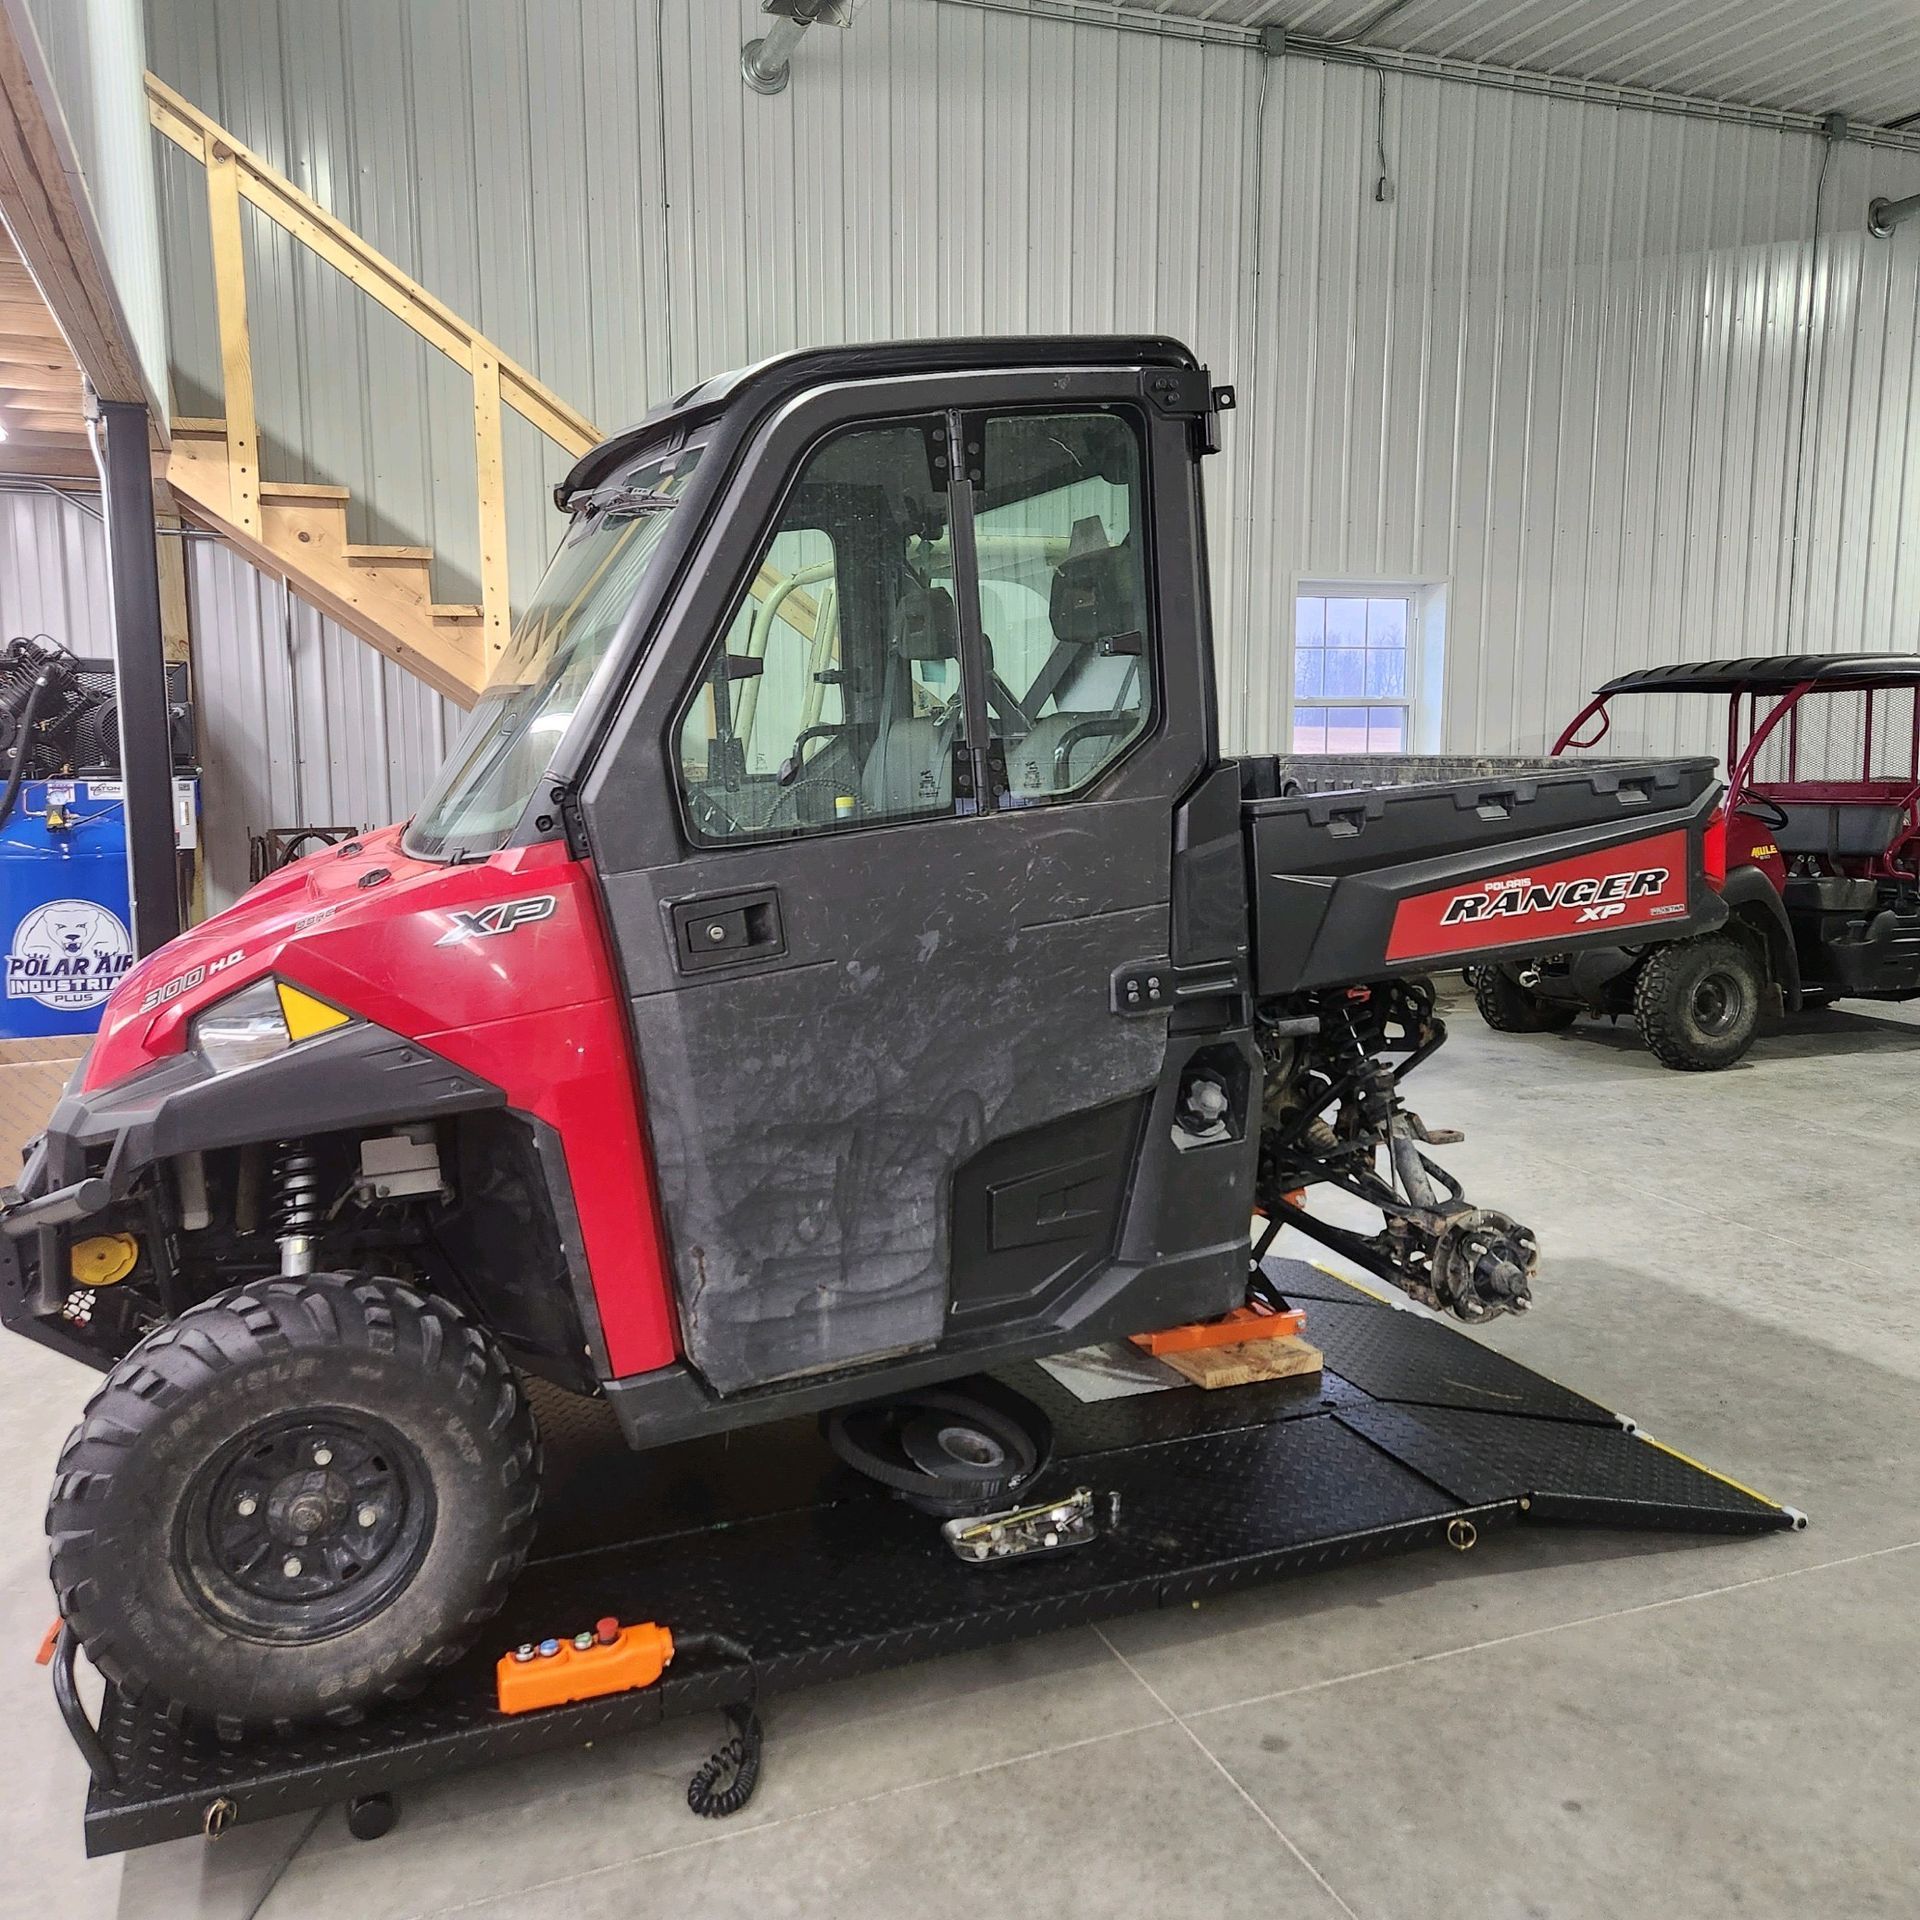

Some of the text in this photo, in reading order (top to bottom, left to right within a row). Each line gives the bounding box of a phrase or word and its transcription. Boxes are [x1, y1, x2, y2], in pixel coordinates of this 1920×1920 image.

[1751, 845, 1778, 858] MULE
[1485, 878, 1532, 892] POLARIS
[1440, 868, 1669, 926] RANGER
[433, 895, 556, 948] XP
[1575, 903, 1627, 924] XP
[10, 957, 90, 976] POLAR
[10, 976, 121, 994] INDUSTRIA
[55, 994, 94, 1003] PLUS
